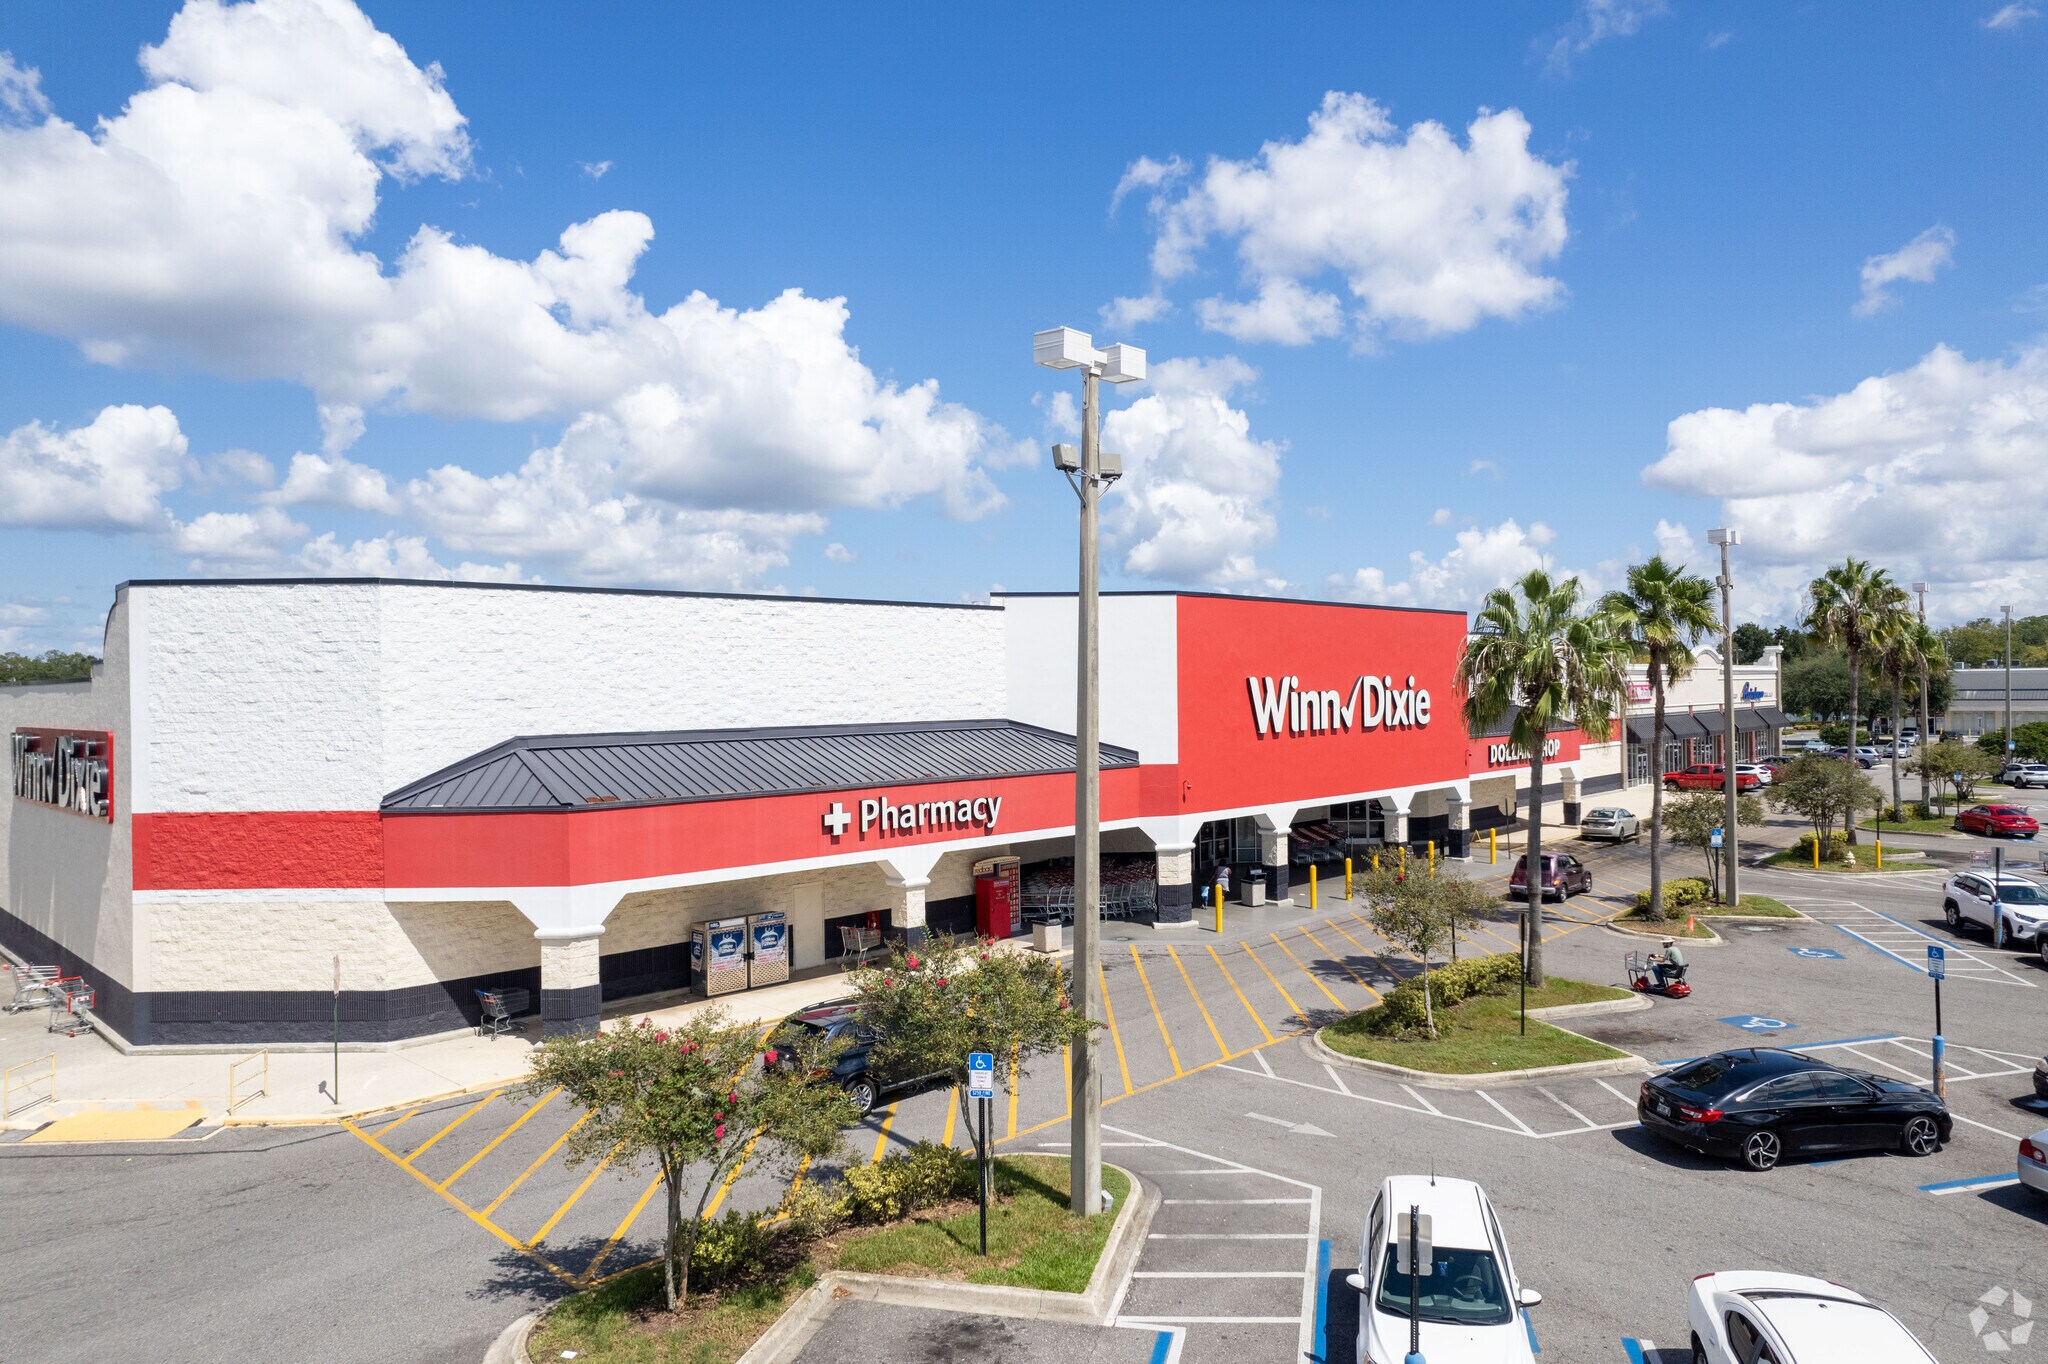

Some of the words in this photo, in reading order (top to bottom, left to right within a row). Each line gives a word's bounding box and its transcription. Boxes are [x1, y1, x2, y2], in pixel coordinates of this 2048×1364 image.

[1249, 676, 1340, 733] Winn
[1363, 675, 1431, 728] Dixie
[1542, 739, 1560, 757] HOP
[58, 736, 102, 817] Dixie
[861, 796, 1002, 833] Pharmacy
